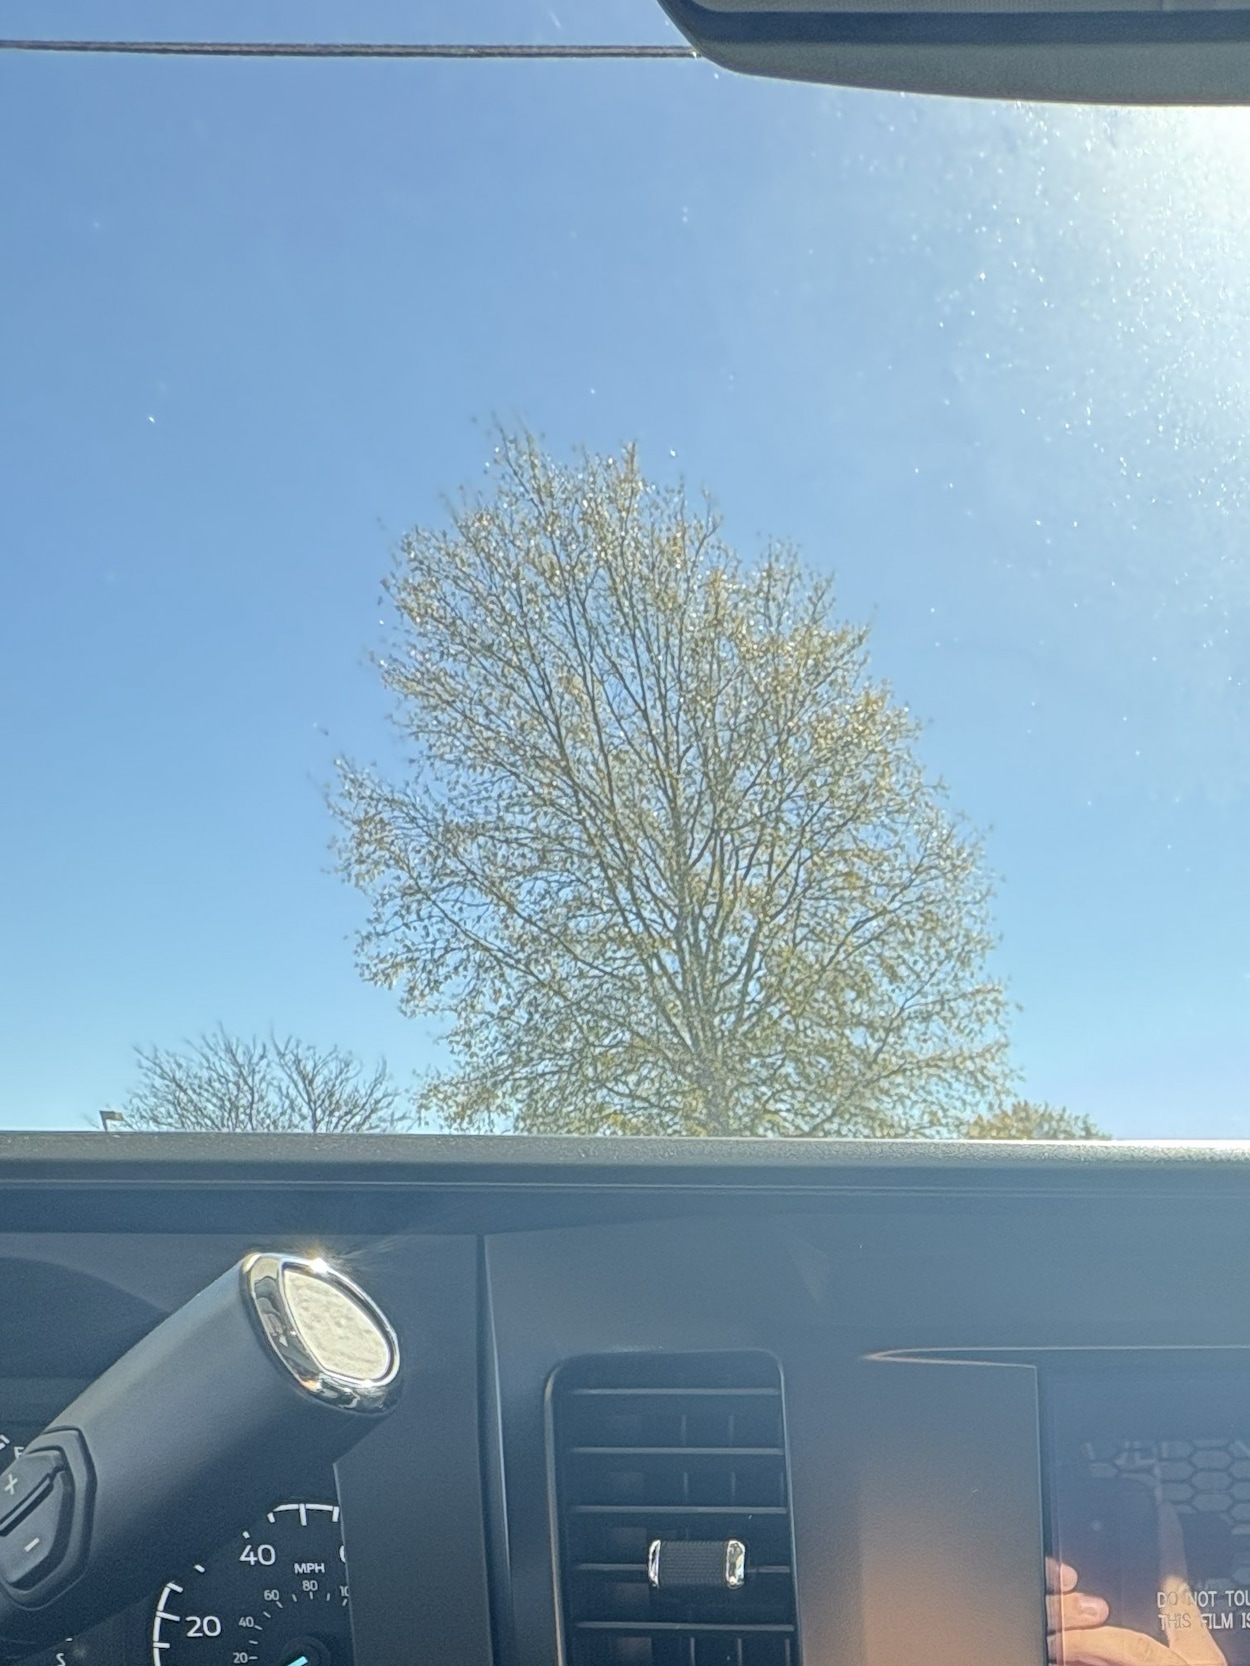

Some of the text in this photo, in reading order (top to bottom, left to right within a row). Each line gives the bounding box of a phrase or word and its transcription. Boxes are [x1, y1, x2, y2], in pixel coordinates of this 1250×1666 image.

[239, 1544, 276, 1566] 40
[293, 1562, 325, 1574] MPH
[302, 1580, 318, 1592] 80
[264, 1589, 280, 1601] 60
[1157, 1591, 1179, 1609] DO
[1187, 1590, 1218, 1608] NOT
[185, 1615, 222, 1637] 20
[238, 1615, 254, 1628] 40
[1158, 1612, 1192, 1631] THIS
[1200, 1612, 1234, 1630] FILM
[232, 1652, 248, 1664] 20
